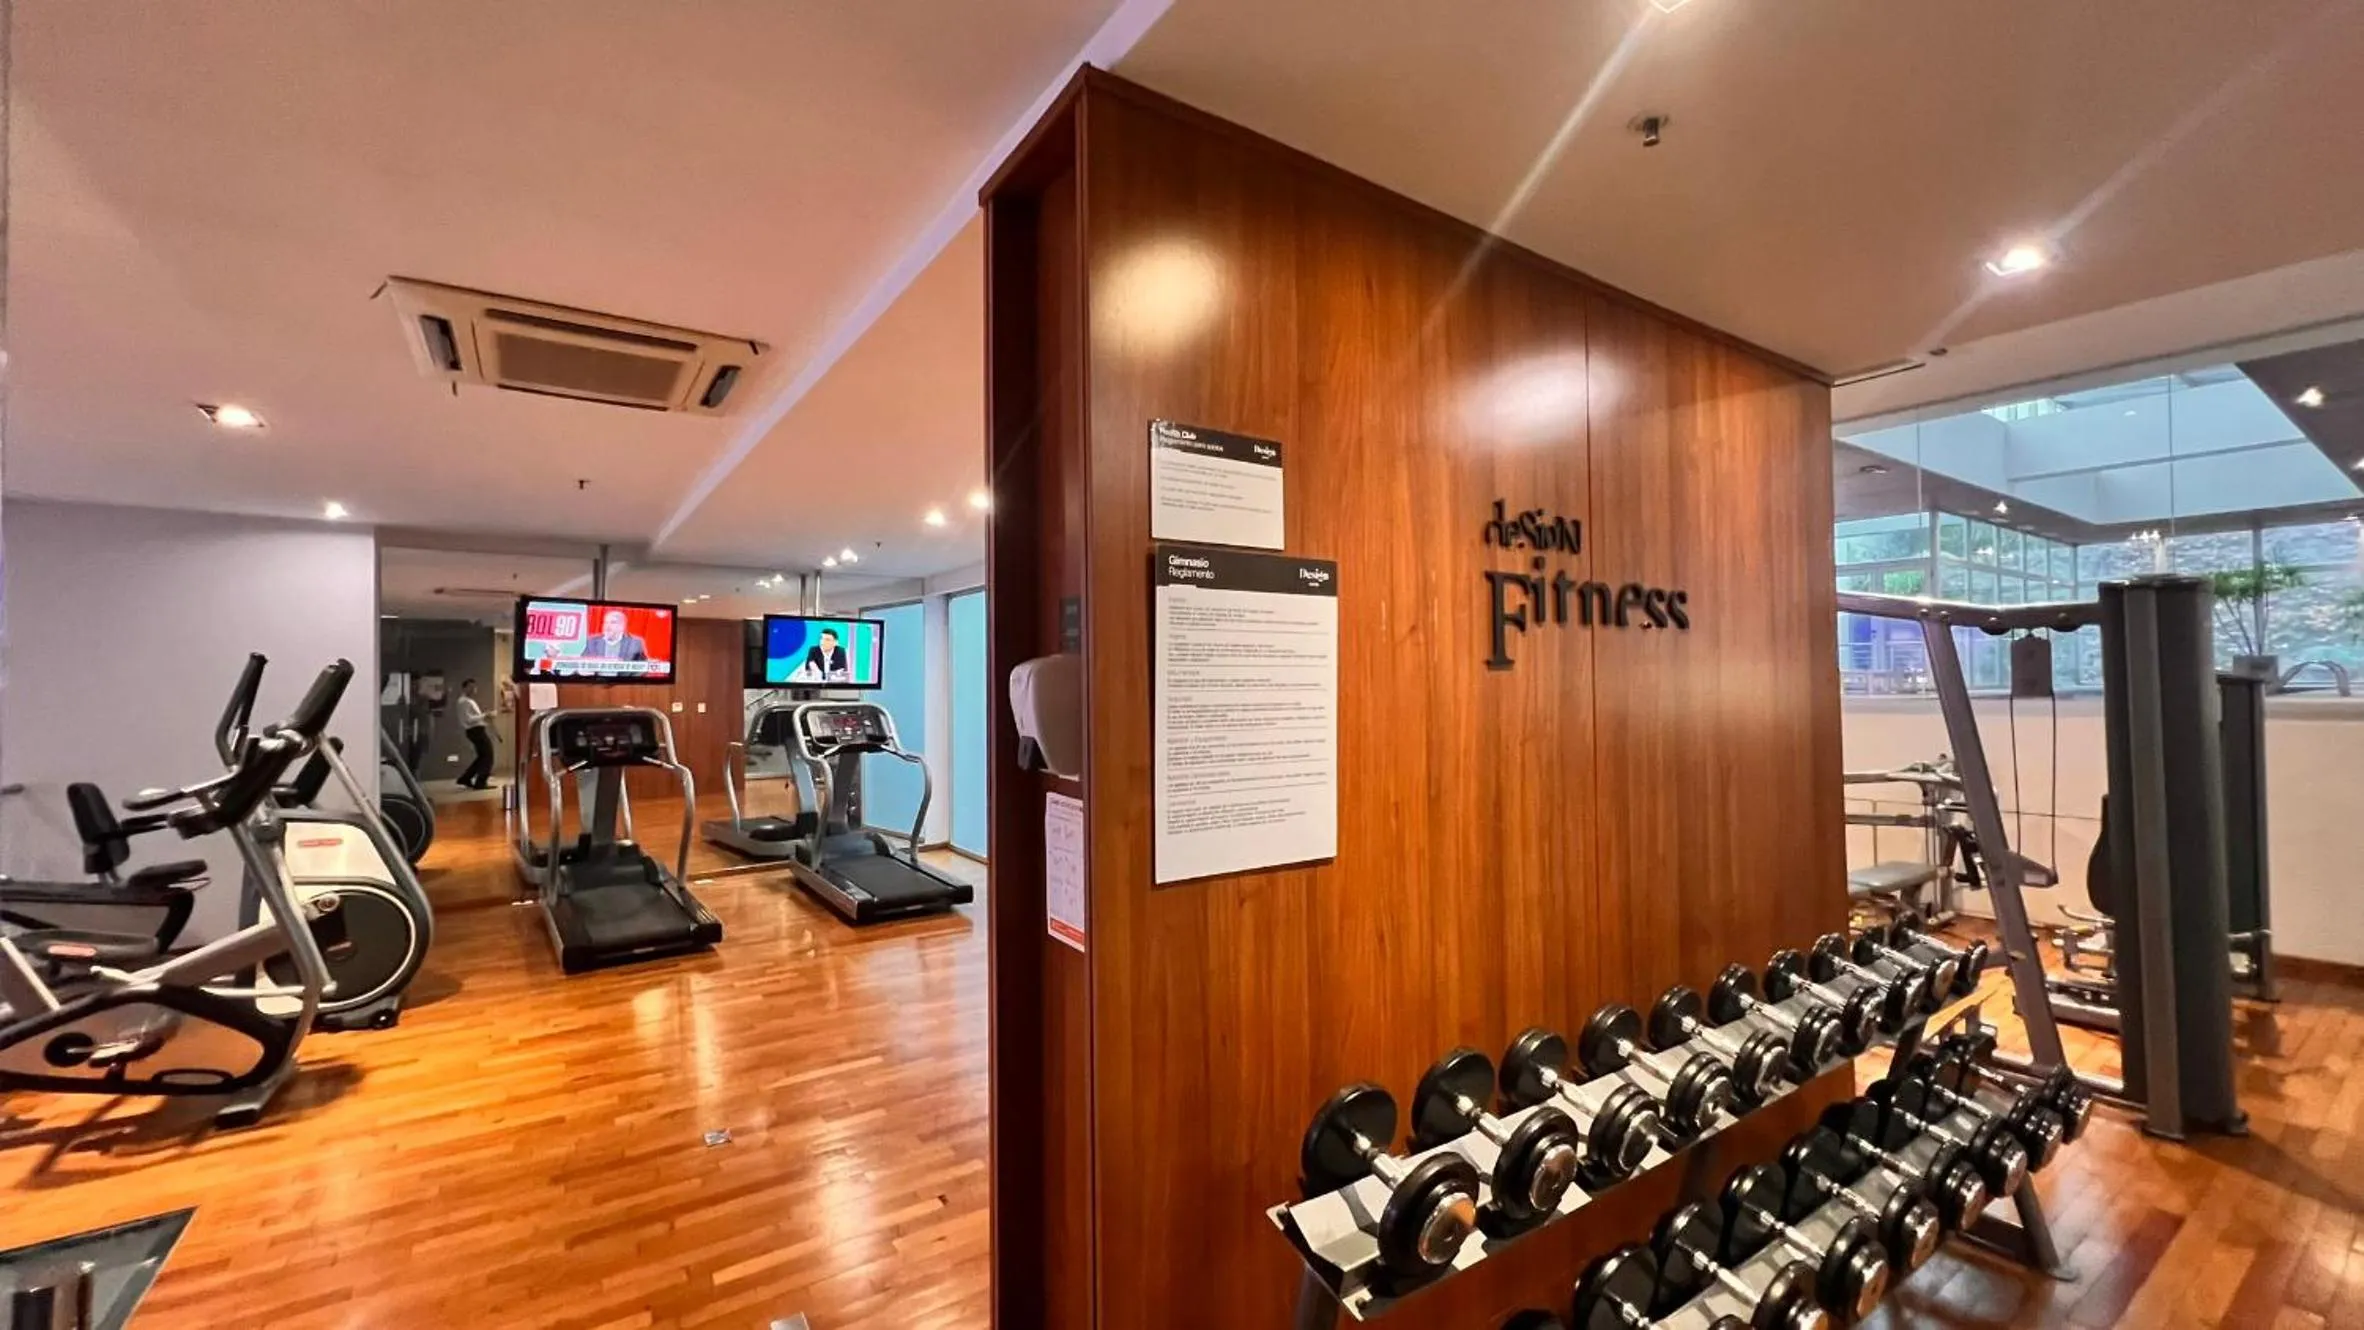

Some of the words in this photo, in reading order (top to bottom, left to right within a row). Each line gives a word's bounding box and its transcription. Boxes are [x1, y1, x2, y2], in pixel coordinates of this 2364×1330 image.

[1168, 553, 1210, 569] Gimnasio
[1168, 565, 1215, 579] Reglamento
[1299, 567, 1330, 583] Design
[1484, 555, 1690, 672] Fitness
